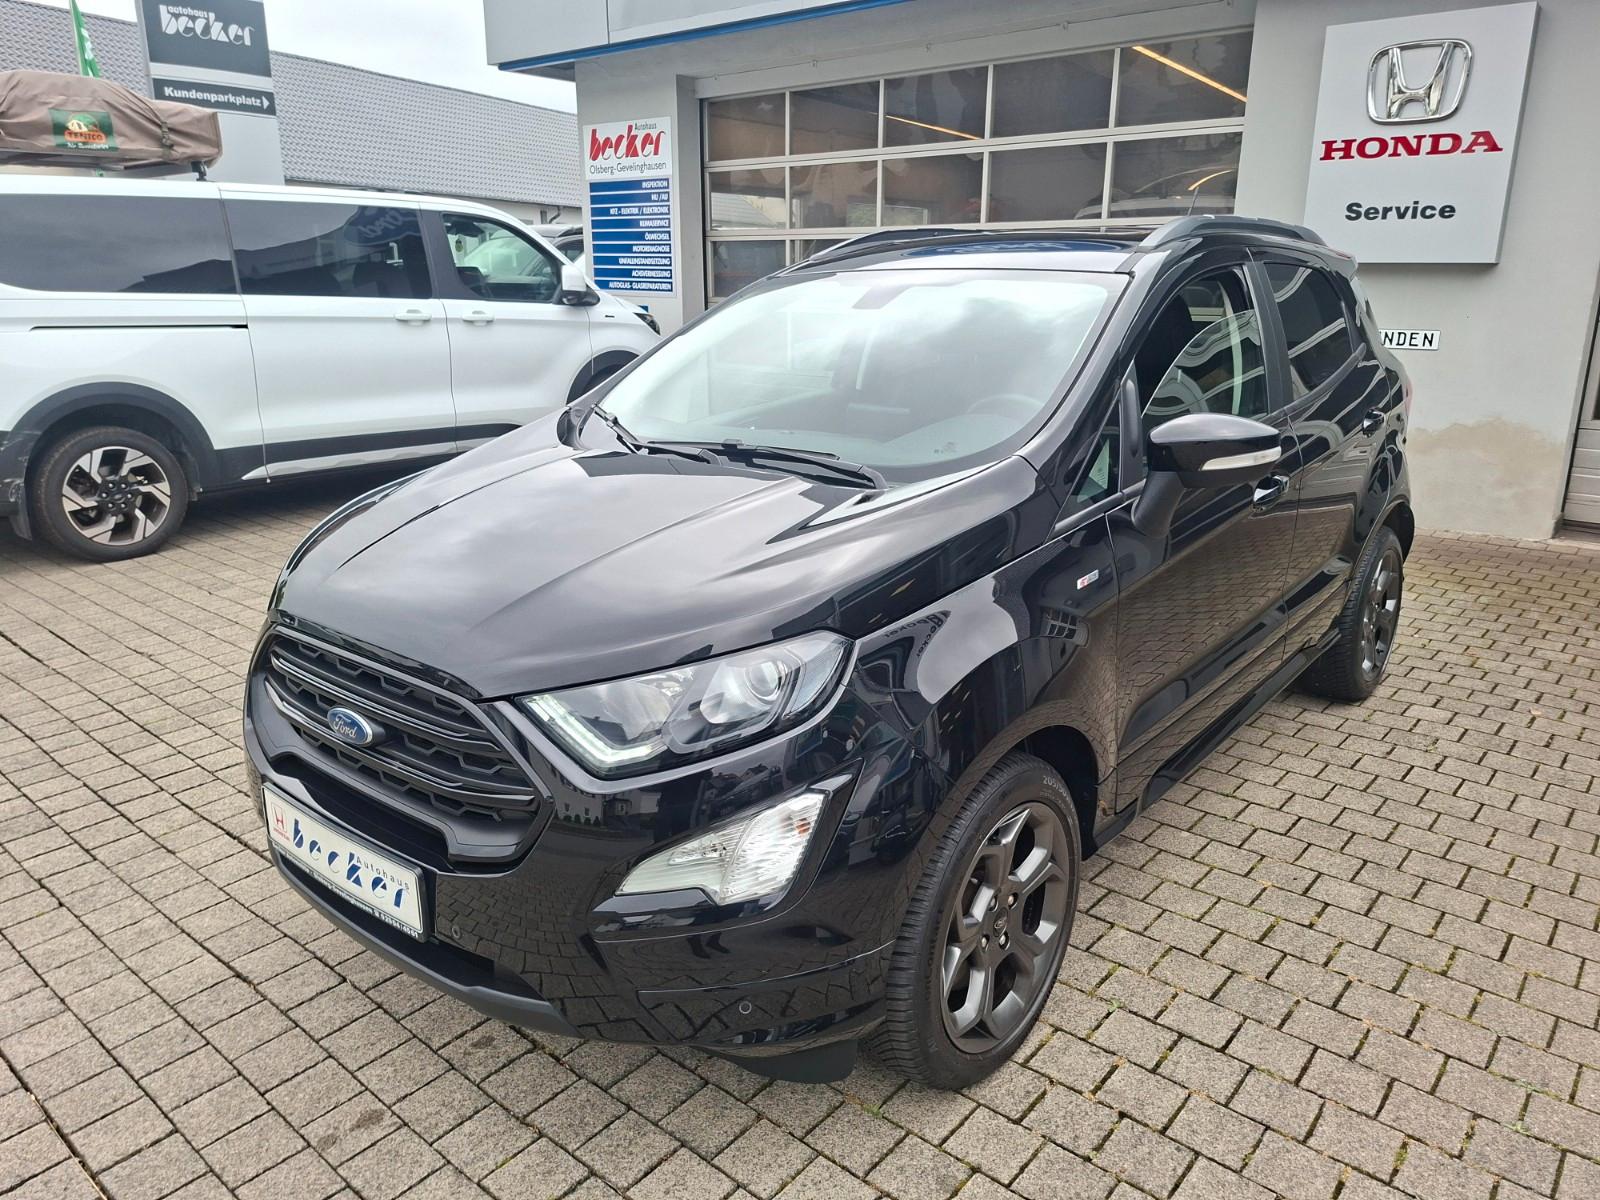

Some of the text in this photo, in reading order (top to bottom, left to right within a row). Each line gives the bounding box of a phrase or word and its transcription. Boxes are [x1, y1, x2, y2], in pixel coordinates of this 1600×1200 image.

[160, 5, 255, 46] becker
[164, 86, 261, 106] Kundenparkplatz
[589, 124, 666, 161] becker
[1319, 130, 1503, 161] HONDA
[590, 161, 667, 176] Olsberg-Gevelinghausen
[642, 180, 668, 189] INSPEKTION
[1344, 200, 1456, 221] Service
[1380, 331, 1434, 347] NDEN
[334, 714, 358, 738] Ford
[293, 818, 405, 909] becker
[356, 856, 410, 891] Autohaus
